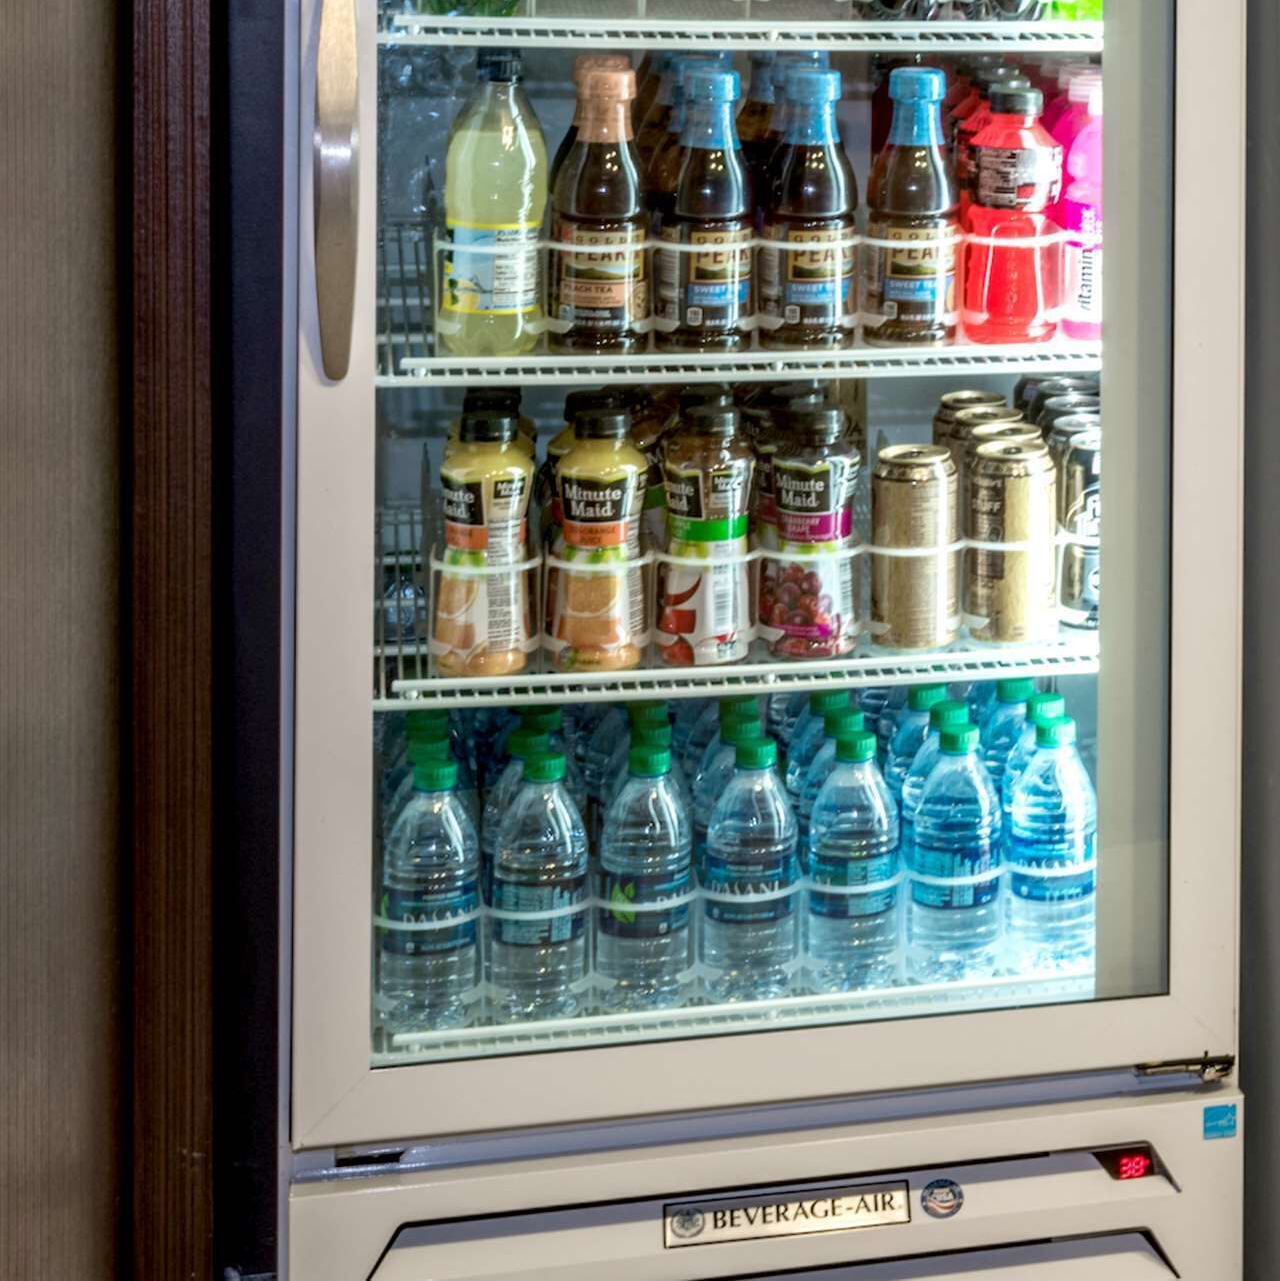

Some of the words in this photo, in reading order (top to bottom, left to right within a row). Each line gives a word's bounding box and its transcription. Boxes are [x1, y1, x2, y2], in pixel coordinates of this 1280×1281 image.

[594, 285, 613, 294] TEA
[564, 482, 622, 502] Minute
[781, 491, 818, 508] Maid
[571, 500, 613, 518] Maid
[712, 1191, 895, 1230] BEVERAGE-AIR
